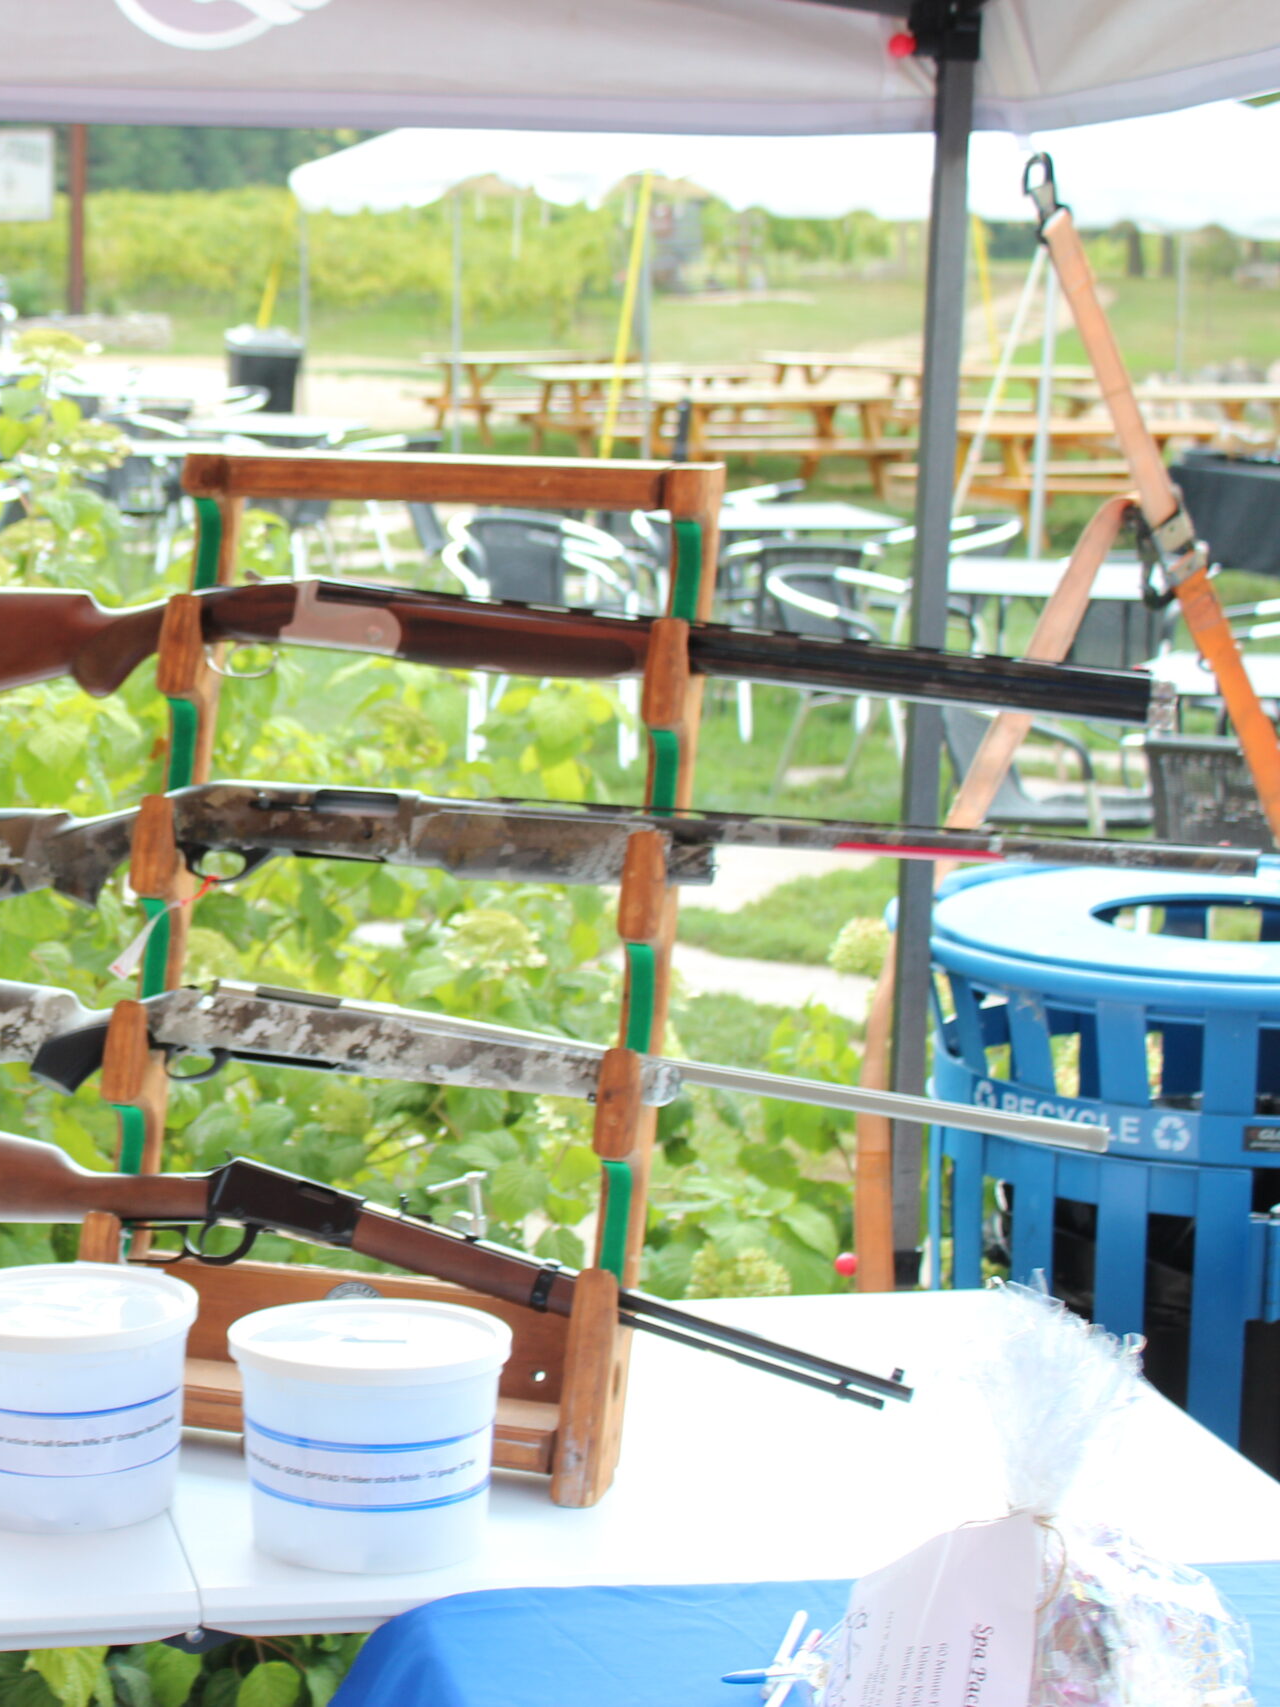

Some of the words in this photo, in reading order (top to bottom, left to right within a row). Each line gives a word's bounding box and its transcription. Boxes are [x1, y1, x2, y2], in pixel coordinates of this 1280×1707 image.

[970, 1623, 994, 1659] Spa
[930, 1659, 947, 1698] Minute
[964, 1666, 987, 1707] Pac
